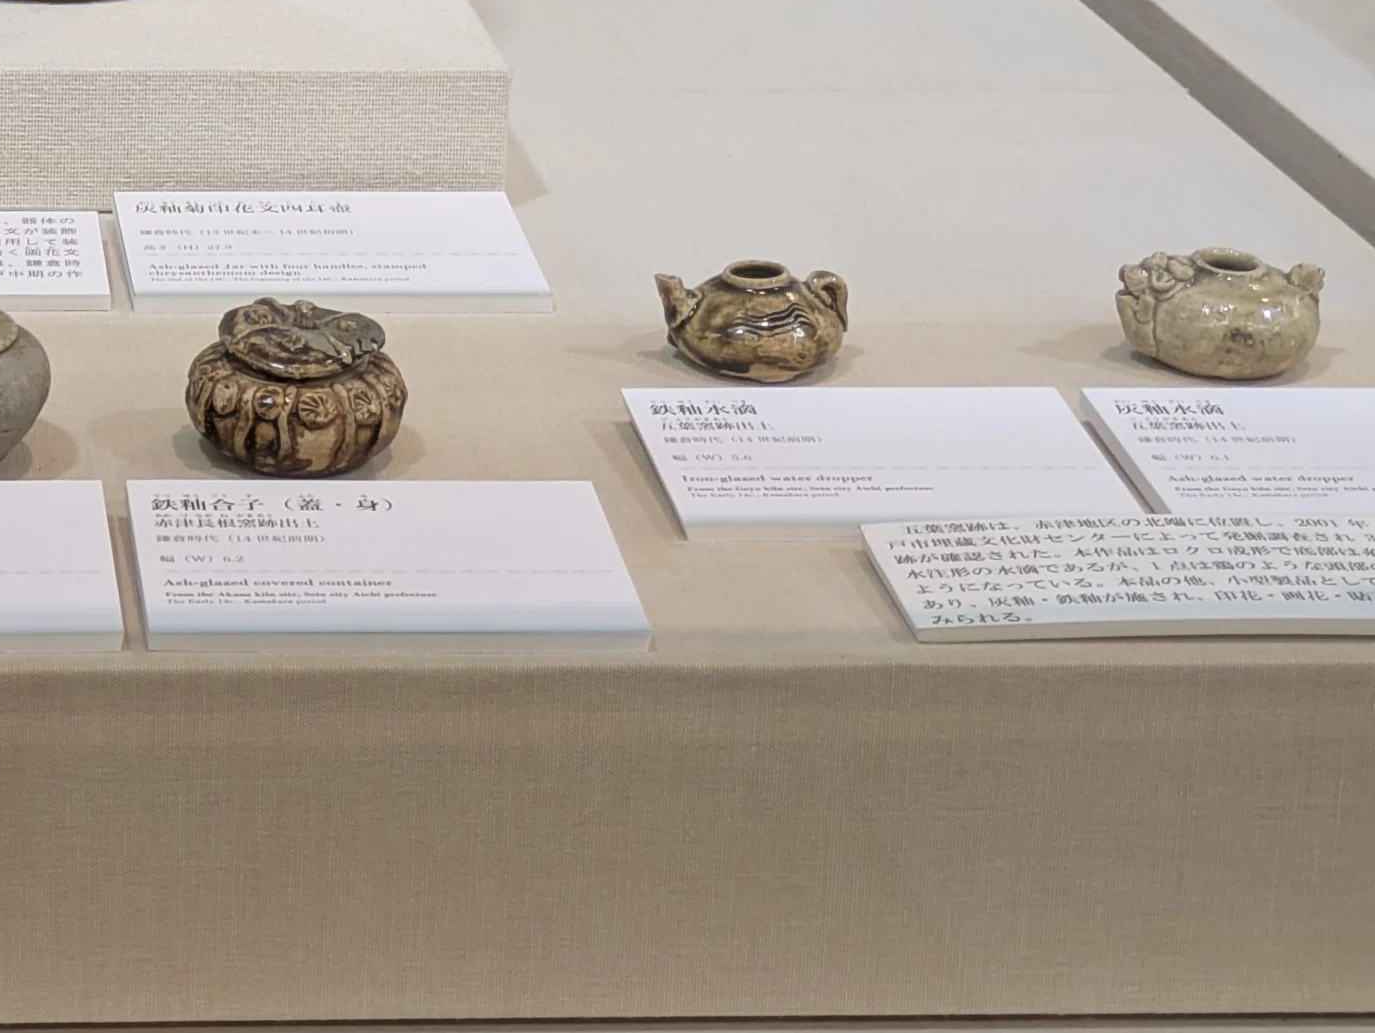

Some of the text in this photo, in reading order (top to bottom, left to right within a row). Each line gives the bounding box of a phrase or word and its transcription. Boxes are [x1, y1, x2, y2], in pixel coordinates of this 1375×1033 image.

[164, 579, 248, 587] Ash-glazed
[931, 612, 1033, 625] みられる。
